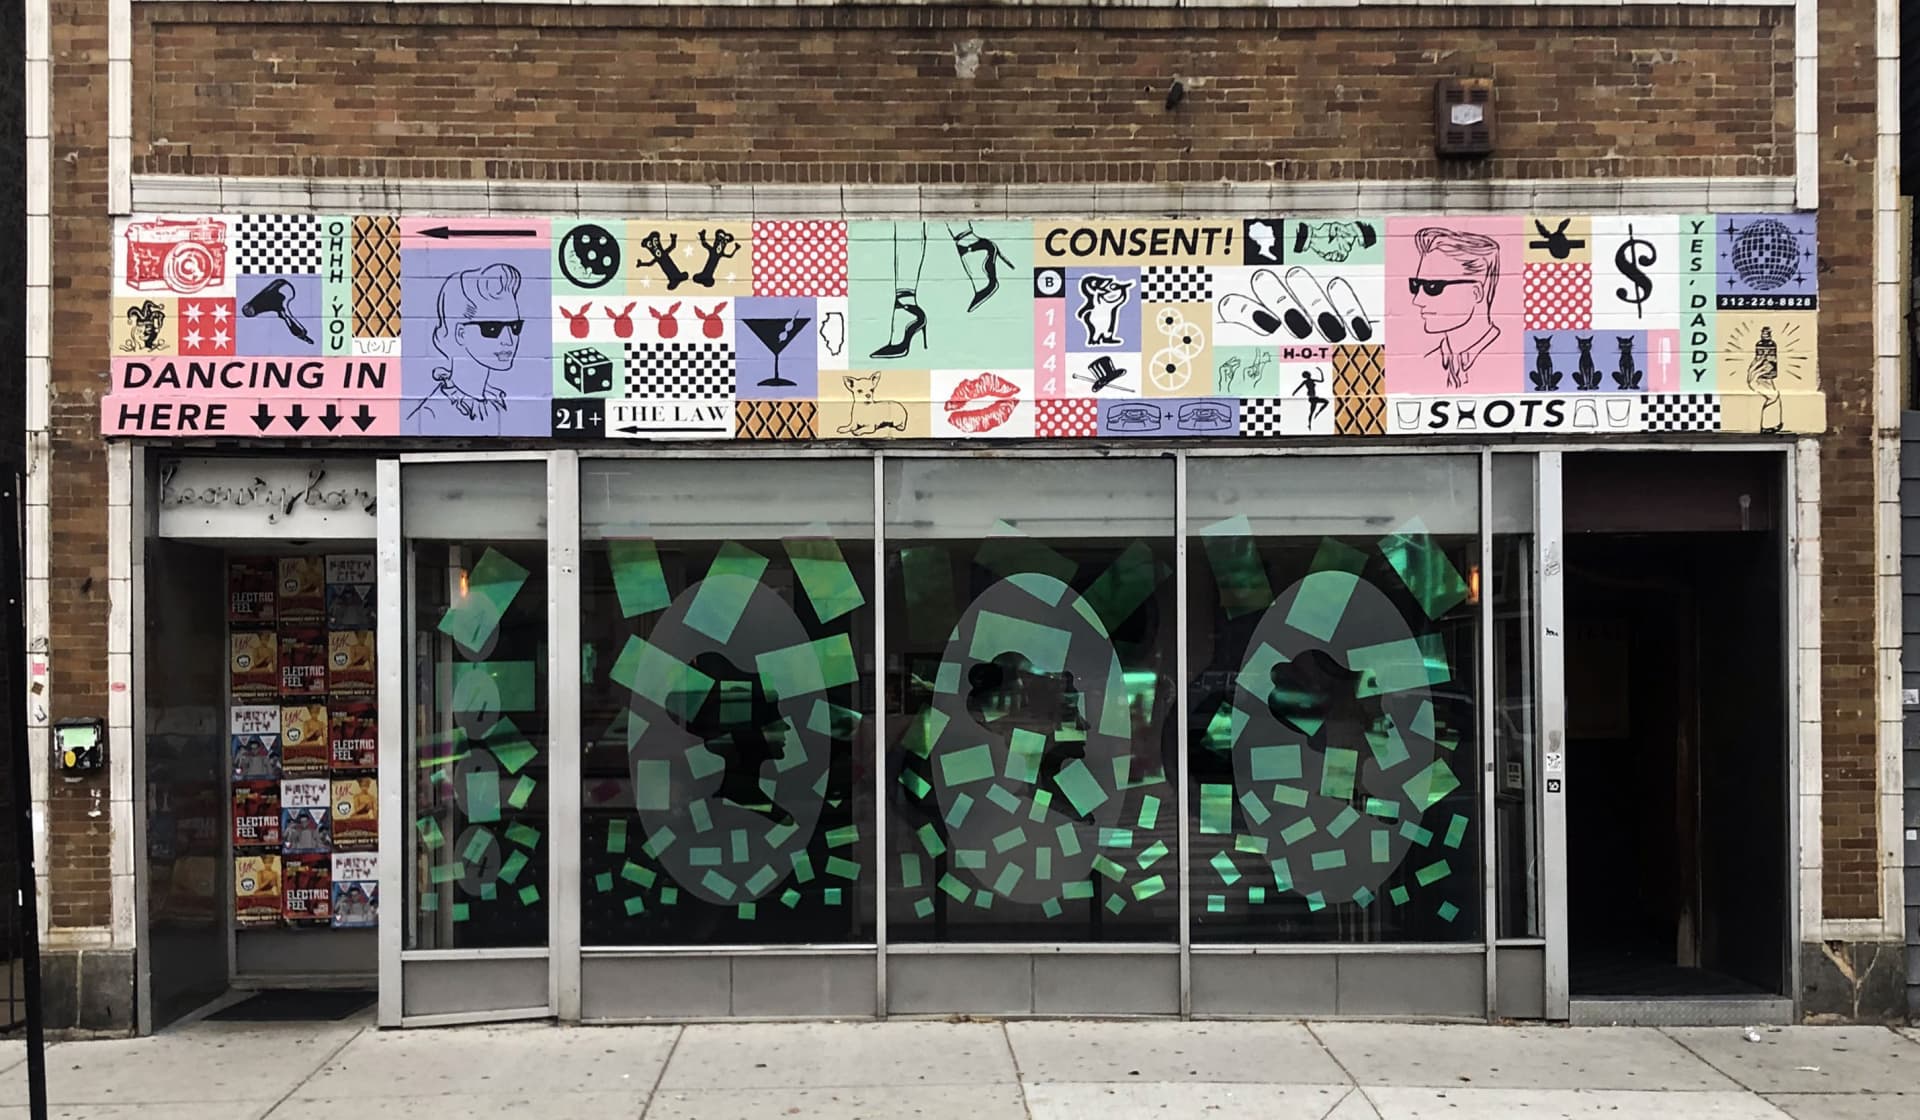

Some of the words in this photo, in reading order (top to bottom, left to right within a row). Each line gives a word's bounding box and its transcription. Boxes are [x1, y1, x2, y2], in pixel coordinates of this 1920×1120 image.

[1044, 227, 1233, 257] CONSENT!
[1690, 294, 1708, 383] DADDY
[1283, 347, 1329, 360] H-O-T
[123, 361, 324, 389] DANCING
[343, 362, 387, 389] IN
[117, 403, 228, 431] HERE
[556, 408, 602, 430] 21+
[613, 406, 665, 422] THE
[674, 406, 730, 422] LAW
[330, 560, 371, 570] PARTY
[232, 604, 253, 614] FEEL
[282, 666, 325, 677] ELECTRIC
[282, 678, 304, 688] FEEL
[235, 711, 277, 722] PARTY
[333, 739, 375, 750] ELECTRIC
[333, 751, 354, 761] FEEL
[284, 783, 327, 795] PARTY
[236, 816, 279, 827] ELECTRIC
[236, 828, 258, 838] FEEL
[336, 857, 378, 868] PARTY
[287, 889, 329, 900] ELECTRIC
[288, 901, 308, 911] FEEL
